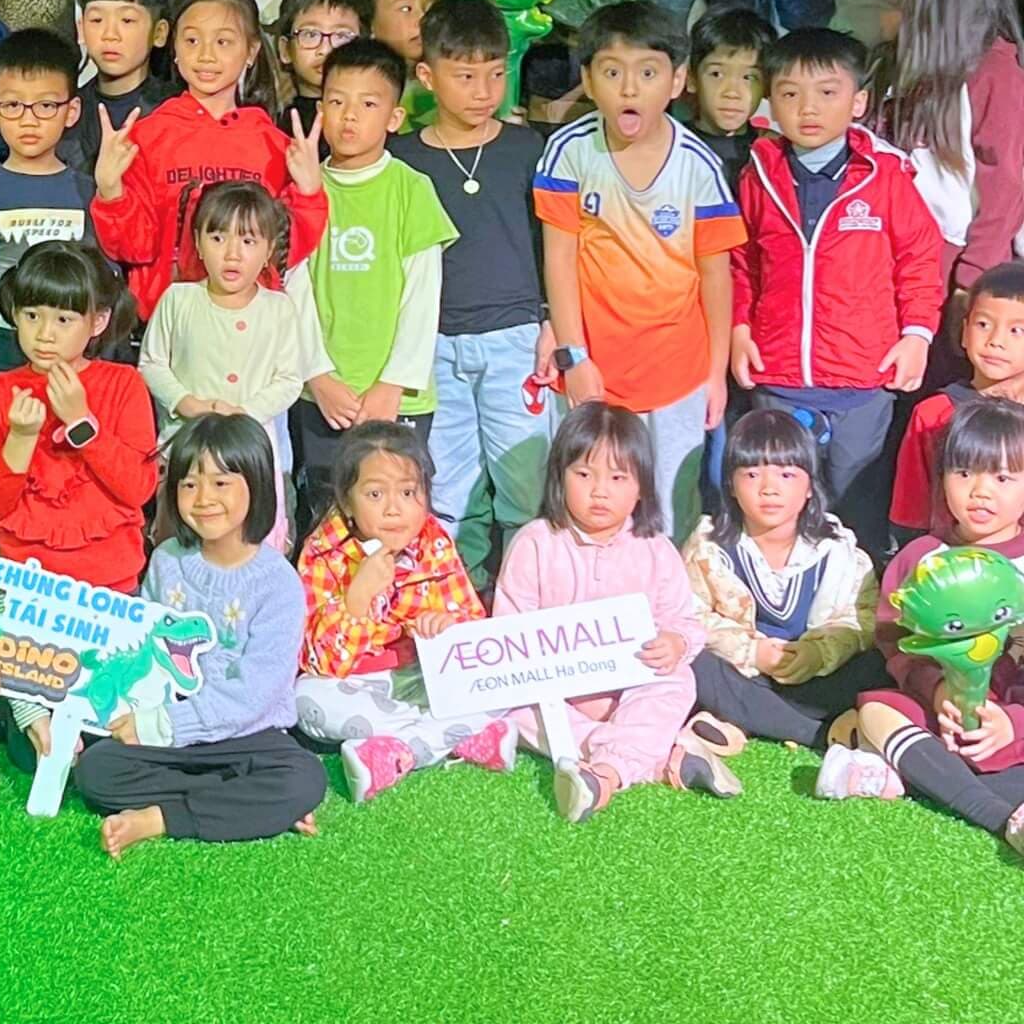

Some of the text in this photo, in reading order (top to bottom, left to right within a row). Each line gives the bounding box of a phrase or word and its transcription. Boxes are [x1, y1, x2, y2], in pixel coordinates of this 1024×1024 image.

[8, 597, 110, 646] TÁI SINH
[78, 586, 146, 624] LONG
[536, 615, 636, 657] MALL
[511, 667, 554, 686] MALL
[555, 665, 576, 678] Ha
[577, 658, 617, 675] Dong
